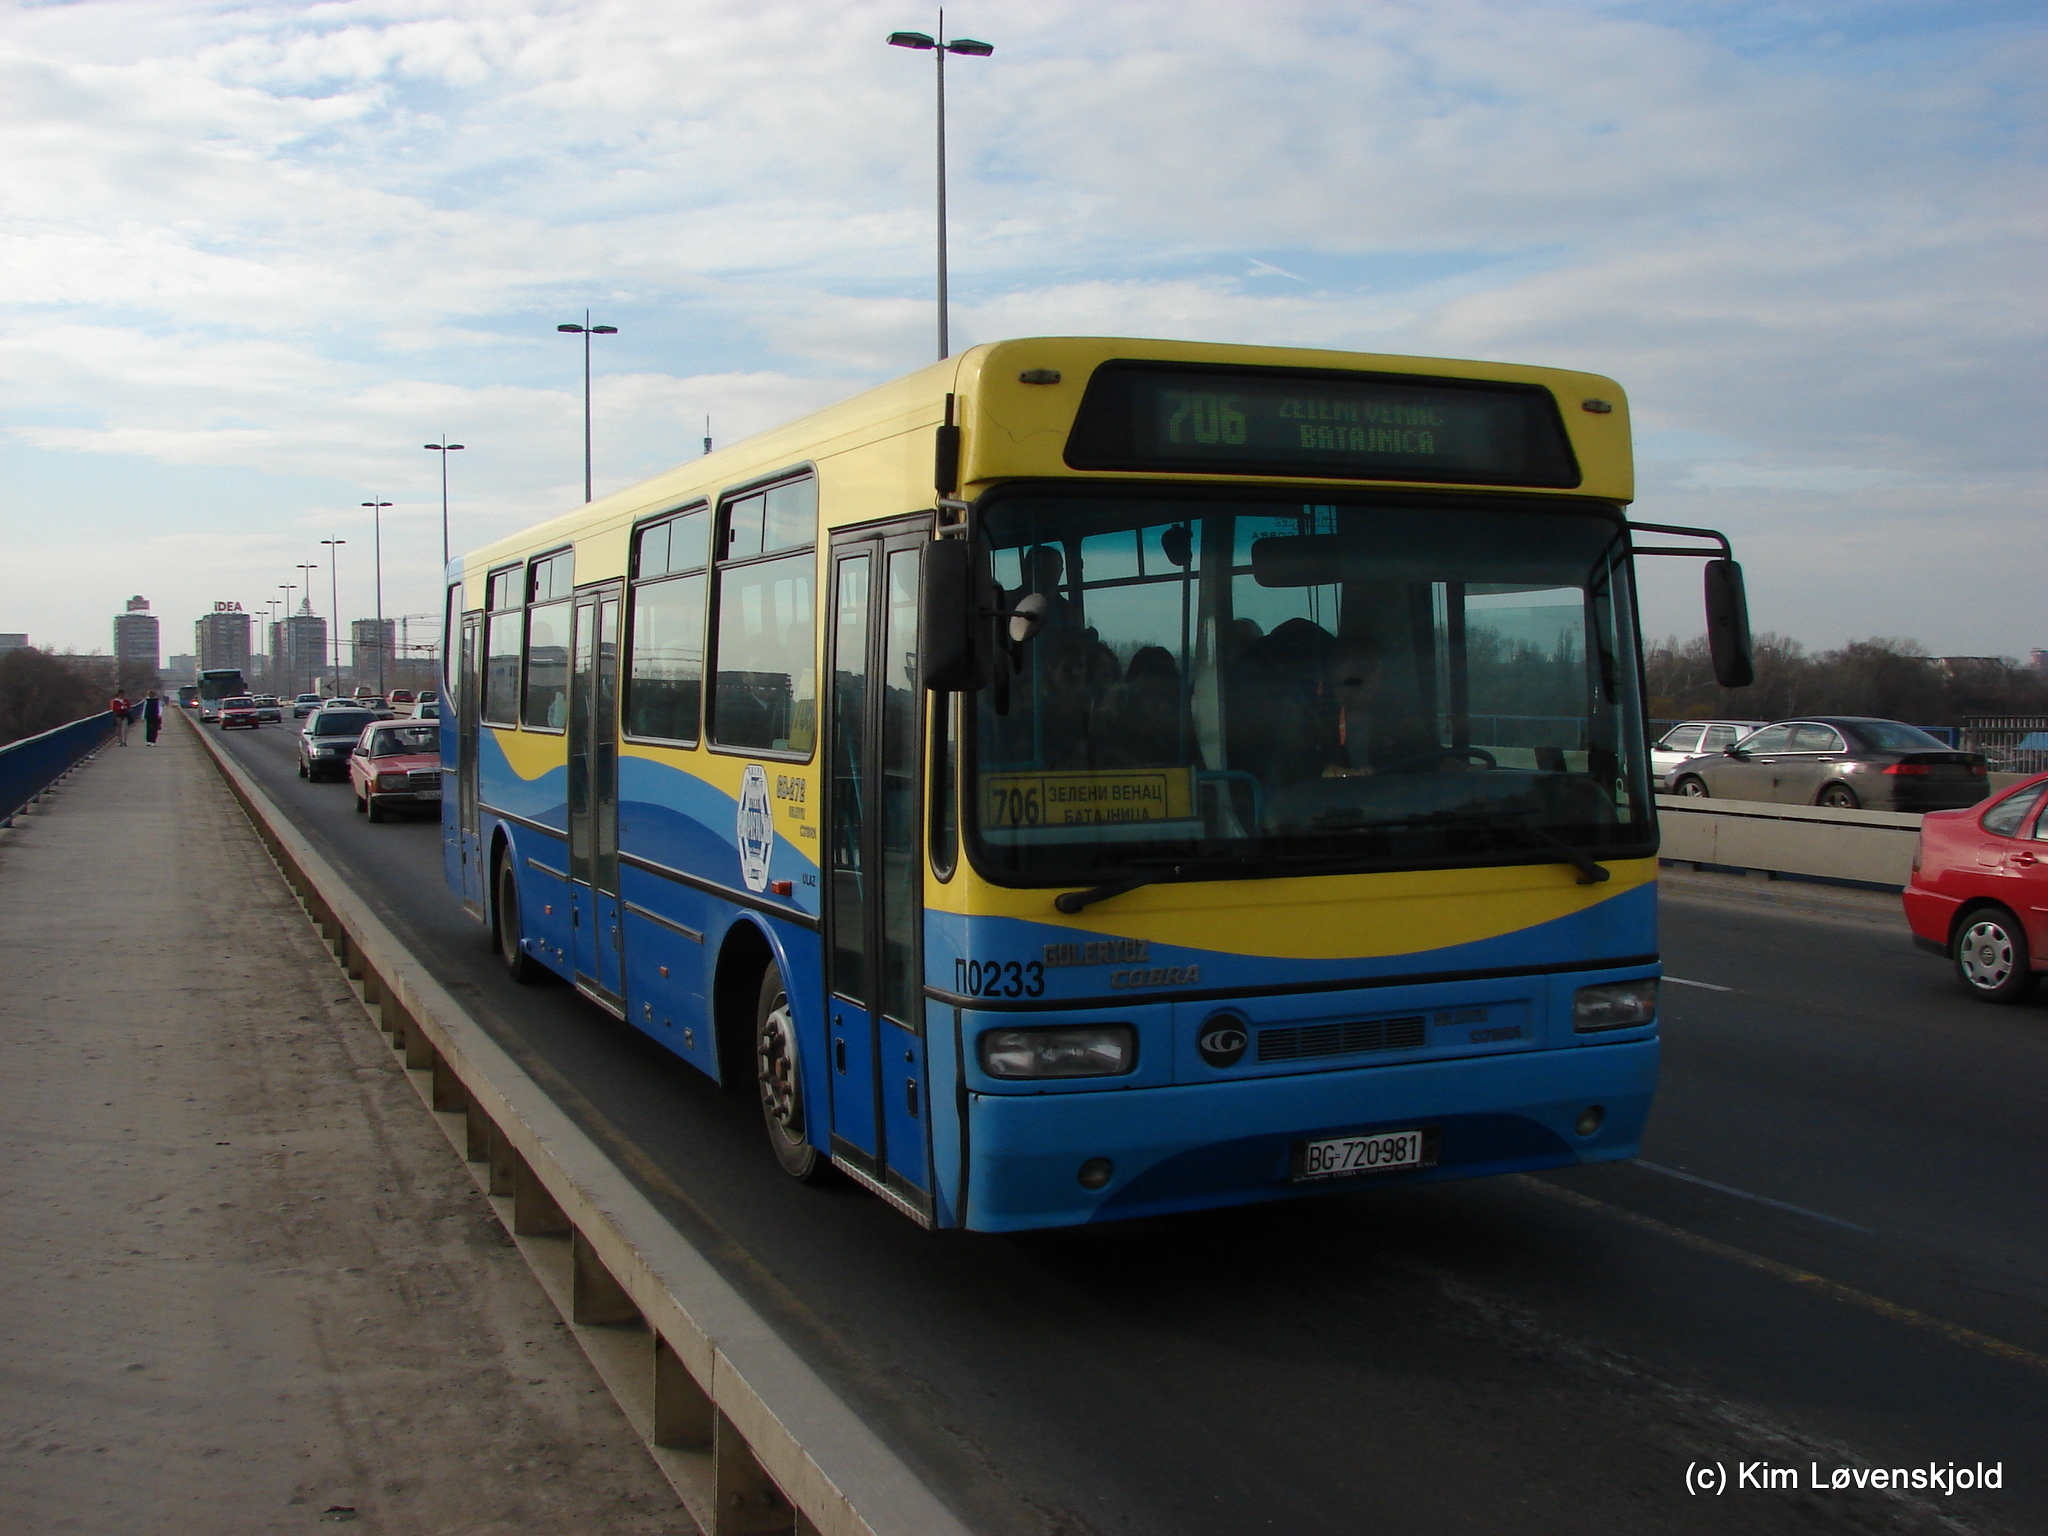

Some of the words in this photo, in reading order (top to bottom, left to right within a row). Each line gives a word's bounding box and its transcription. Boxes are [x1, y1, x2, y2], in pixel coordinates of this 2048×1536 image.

[1300, 425, 1435, 454] BATAJNICA
[993, 787, 1039, 826] 706
[1049, 786, 1108, 803] ЗЕЛЕНИ
[1112, 784, 1162, 804] ВЕНАЦ
[802, 873, 817, 888] ULAZ
[1111, 964, 1199, 990] COBRA
